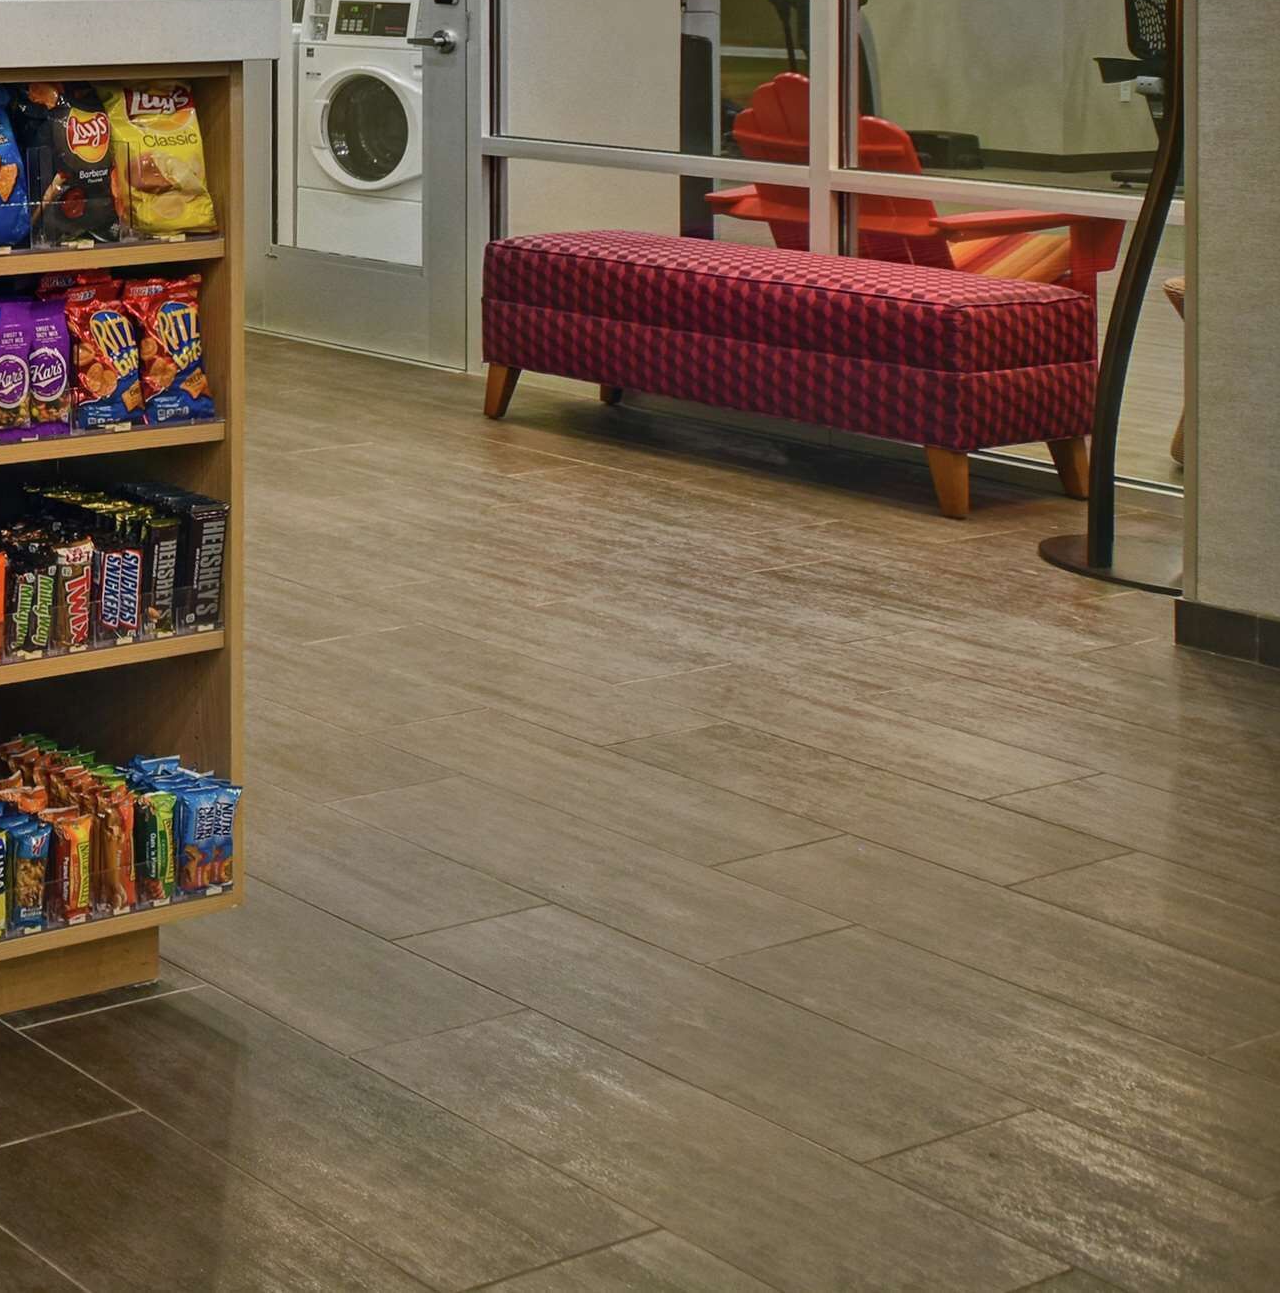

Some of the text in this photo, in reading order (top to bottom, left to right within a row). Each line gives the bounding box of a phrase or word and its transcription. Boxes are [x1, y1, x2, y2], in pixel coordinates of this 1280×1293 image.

[131, 88, 189, 115] Lay's
[71, 115, 108, 147] Lay's
[143, 132, 198, 148] Classic
[79, 170, 109, 179] Barbecue
[91, 317, 137, 355] RITZ
[158, 308, 200, 350] RITZ
[30, 360, 62, 386] Kar's
[195, 521, 225, 616] HERSHEY'S
[102, 553, 121, 627] SNICKERS
[120, 549, 140, 626] SNICKERS
[65, 566, 90, 644] TWIX
[196, 808, 207, 840] GRAIN
[205, 807, 214, 839] NUTRI
[222, 803, 234, 836] NUTRI
